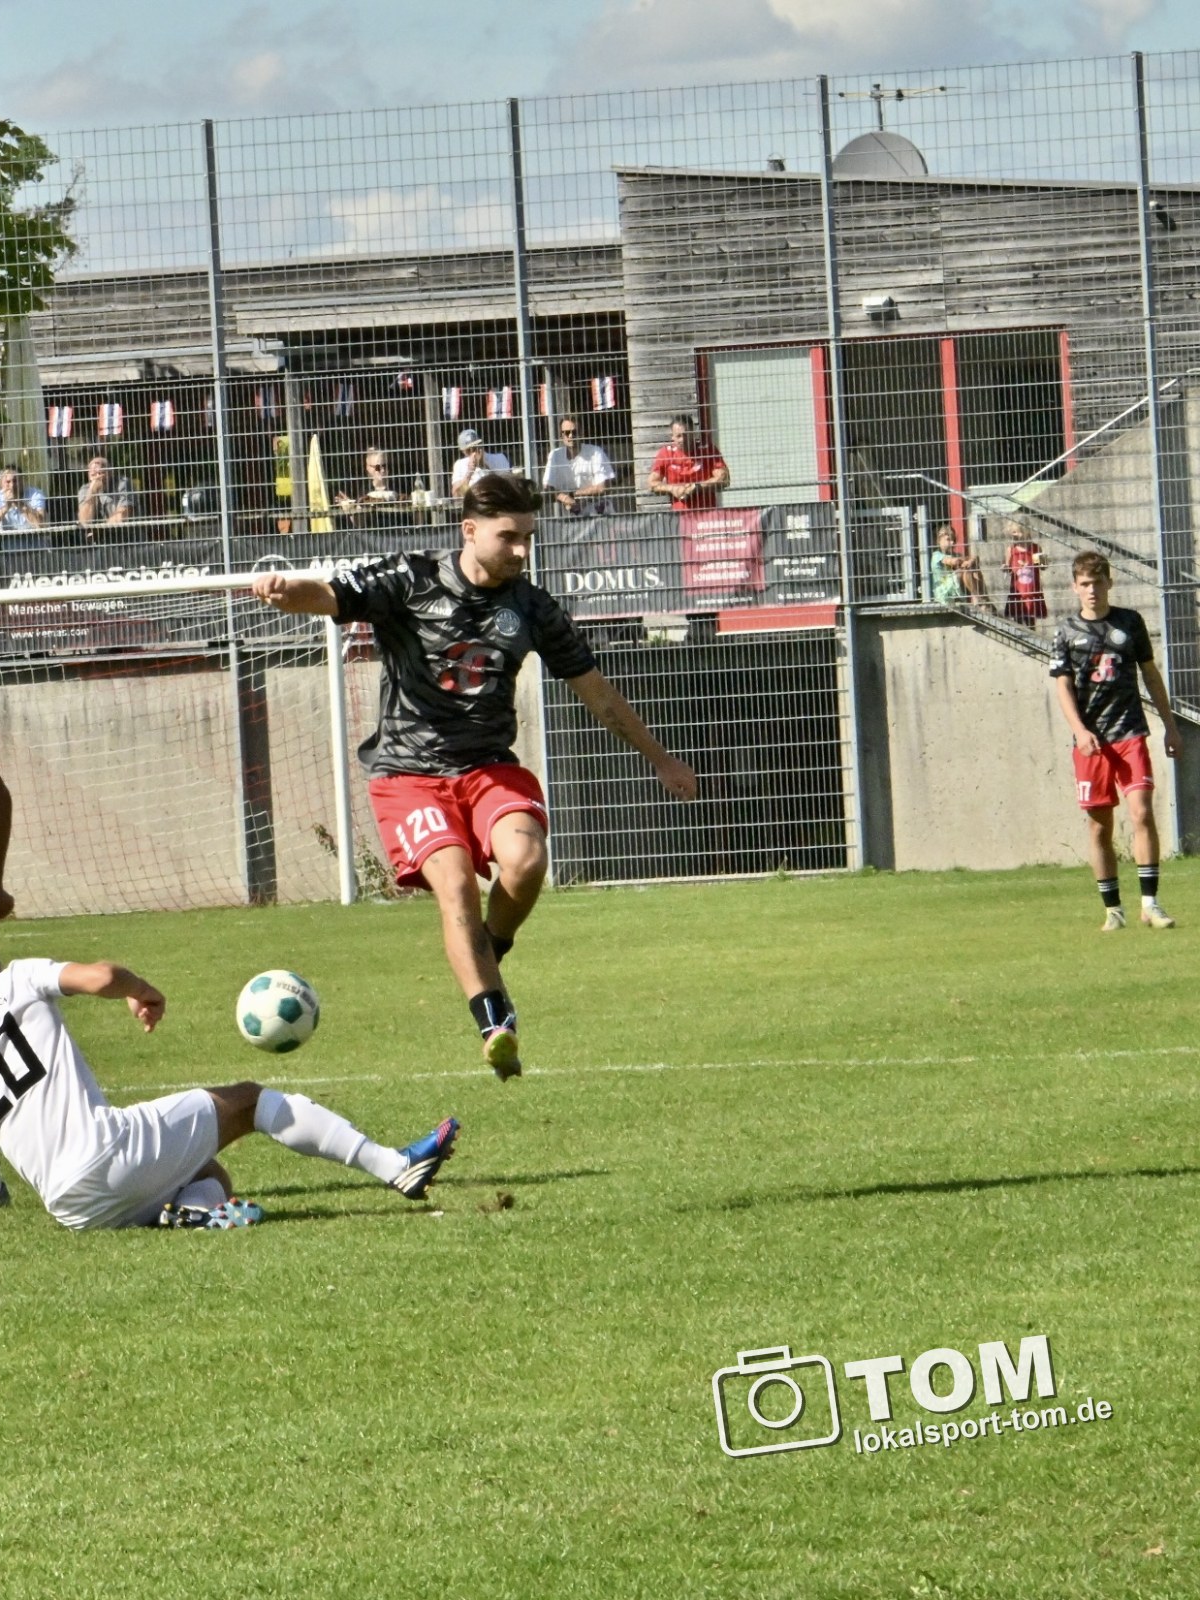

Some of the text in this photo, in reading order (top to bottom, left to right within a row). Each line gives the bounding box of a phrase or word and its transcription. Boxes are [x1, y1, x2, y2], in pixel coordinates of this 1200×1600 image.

[564, 567, 664, 593] DOMUS.
[8, 601, 68, 616] Menschen
[406, 806, 449, 845] 20
